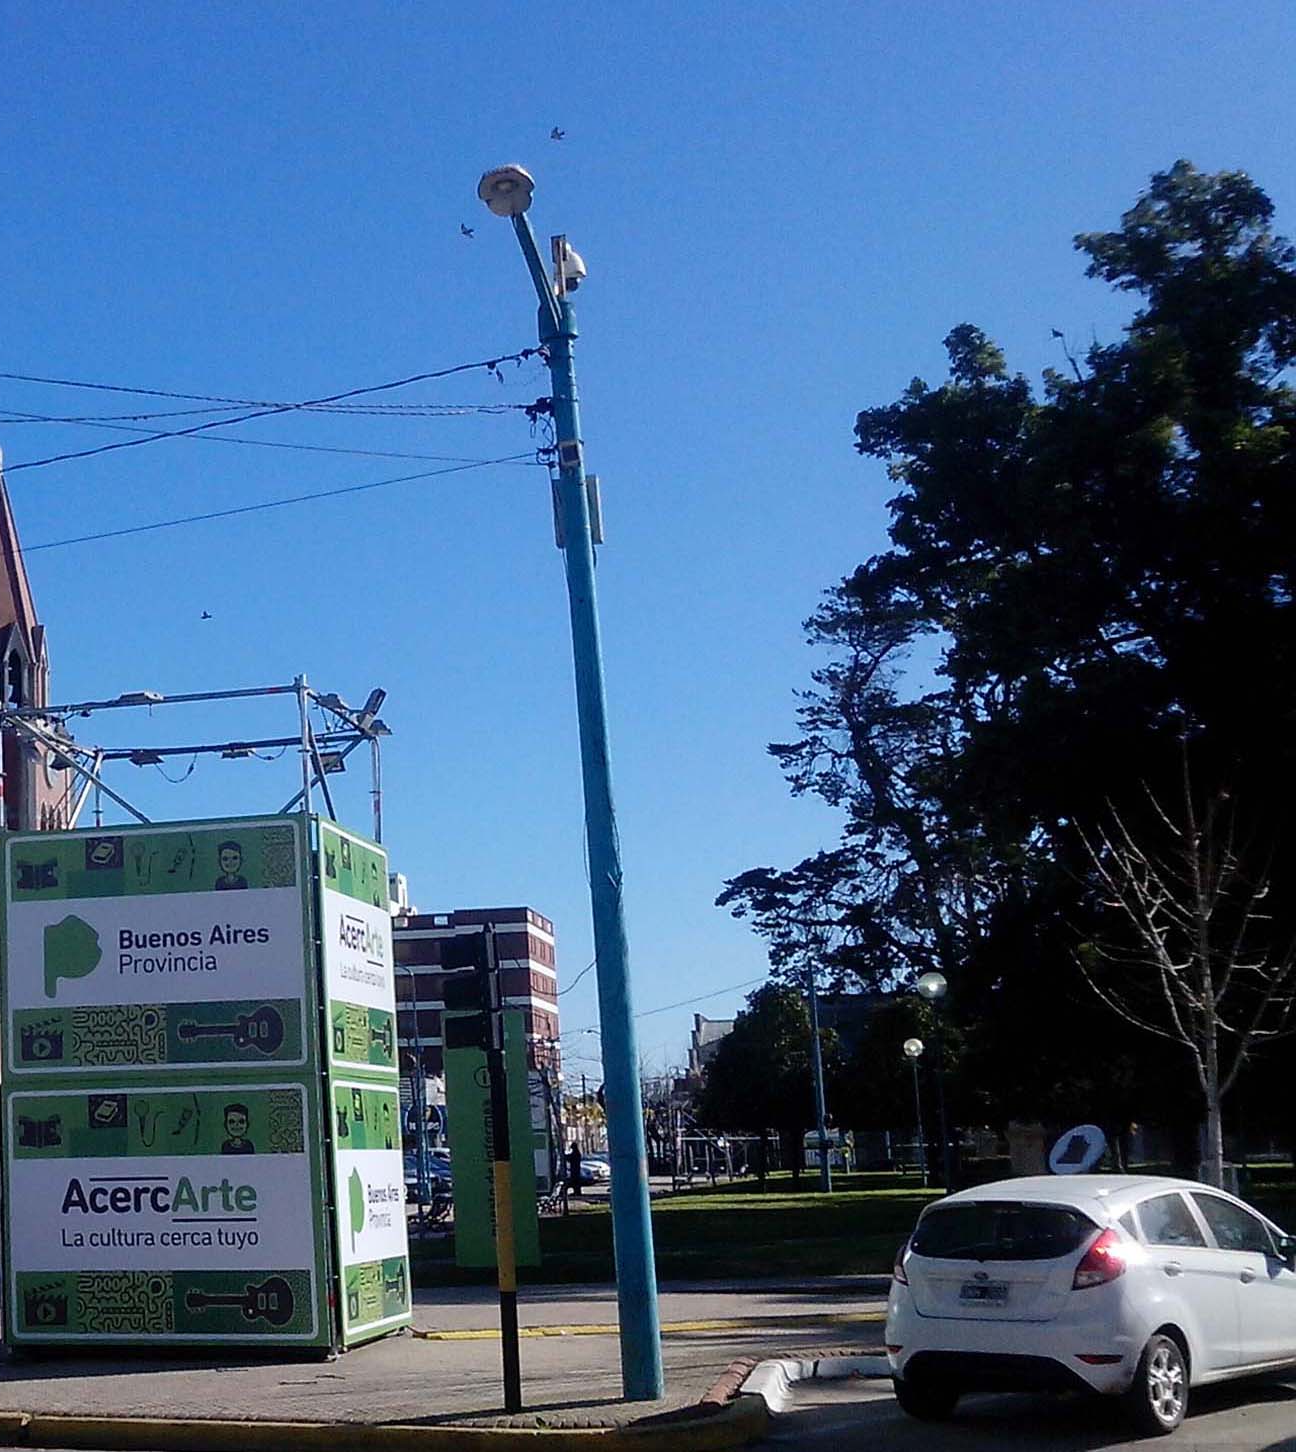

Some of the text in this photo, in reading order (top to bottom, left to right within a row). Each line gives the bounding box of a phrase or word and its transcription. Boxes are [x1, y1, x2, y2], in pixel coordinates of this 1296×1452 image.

[119, 924, 270, 950] Buenos Aires
[119, 951, 217, 974] Provincia
[62, 1176, 258, 1214] AcercArte
[61, 1227, 259, 1251] La cultura cerca tuyo
